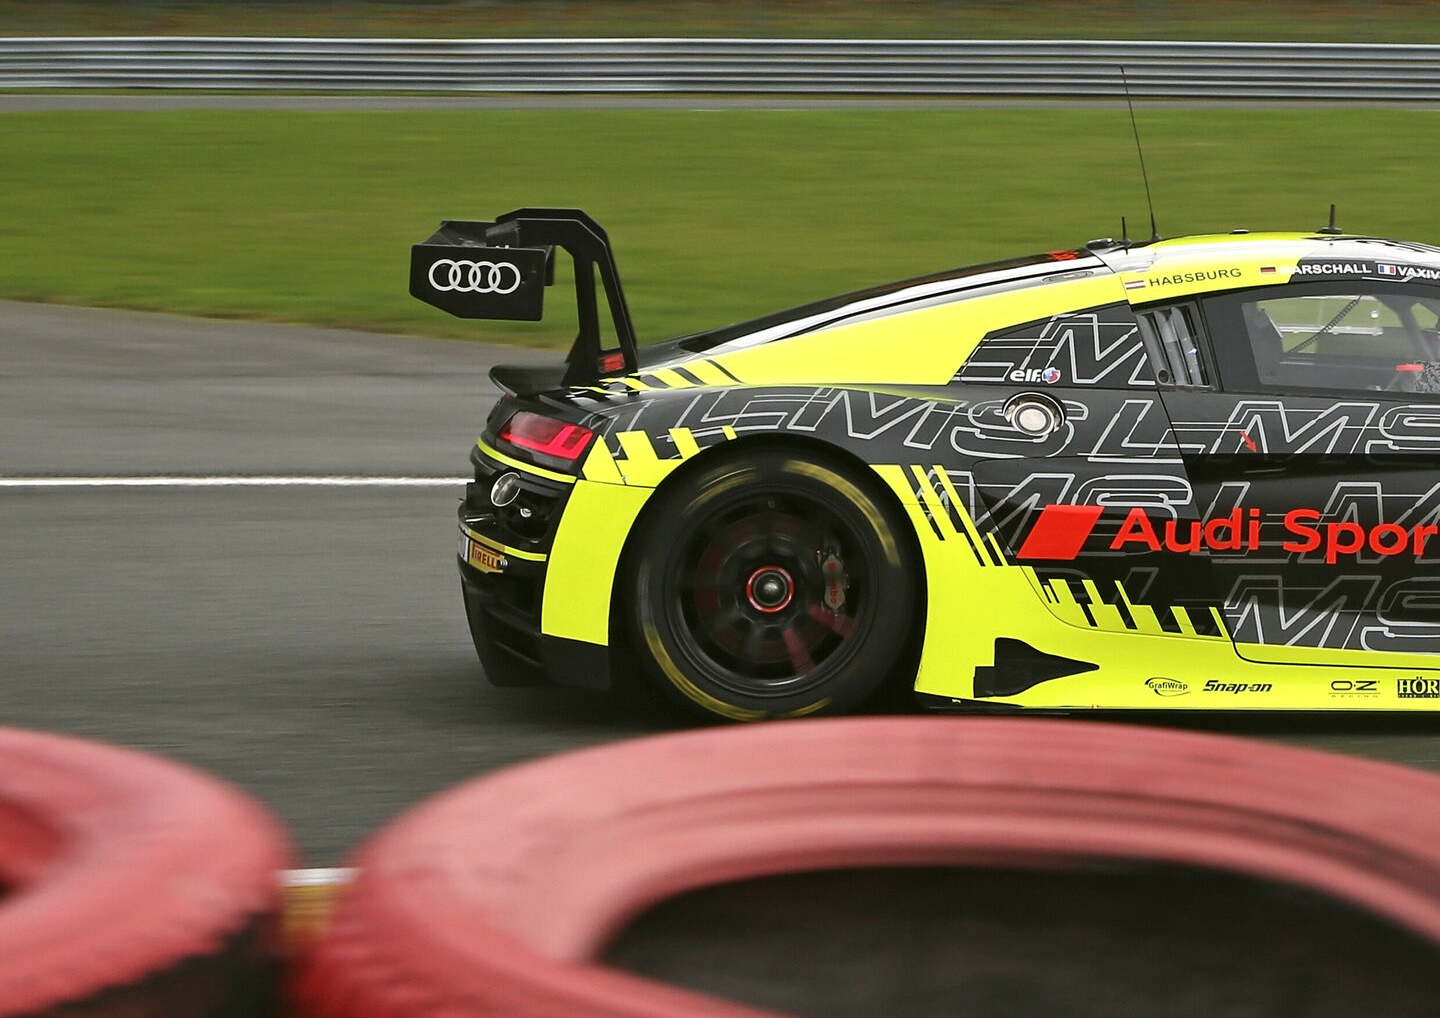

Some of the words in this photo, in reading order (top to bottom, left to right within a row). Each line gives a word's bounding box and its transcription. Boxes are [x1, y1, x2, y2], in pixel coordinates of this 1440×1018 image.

[1150, 268, 1242, 287] HABSBURG
[1110, 507, 1260, 553] Audi
[1148, 682, 1188, 691] GrafiWrap
[1203, 679, 1273, 694] Snap-on
[1398, 676, 1439, 694] HÖR
